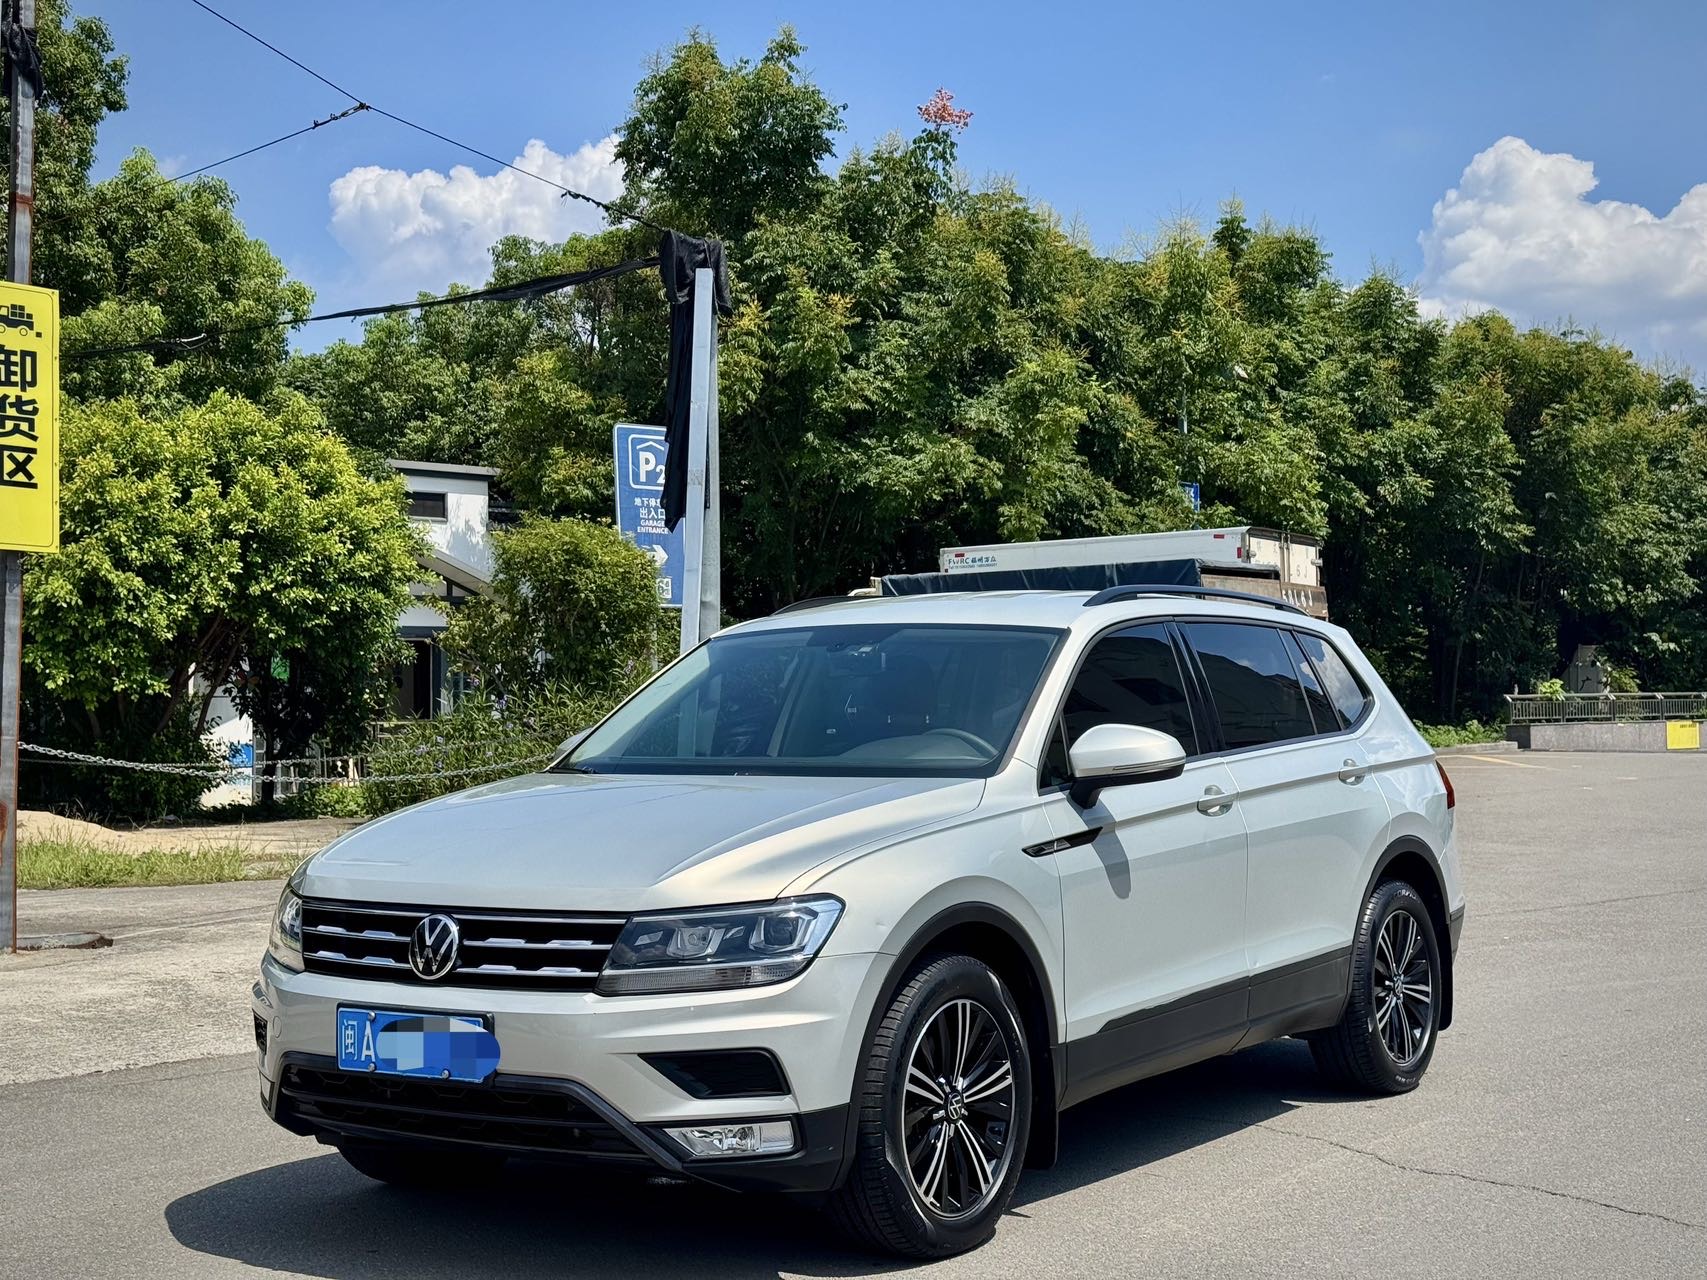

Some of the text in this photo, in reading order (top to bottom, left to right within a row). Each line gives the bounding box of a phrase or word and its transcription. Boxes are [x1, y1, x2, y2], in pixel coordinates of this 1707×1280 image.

[0, 344, 39, 490] 卸货区
[639, 507, 666, 519] 出入口
[640, 519, 665, 527] GARAGE
[637, 526, 668, 534] ENTRANCE
